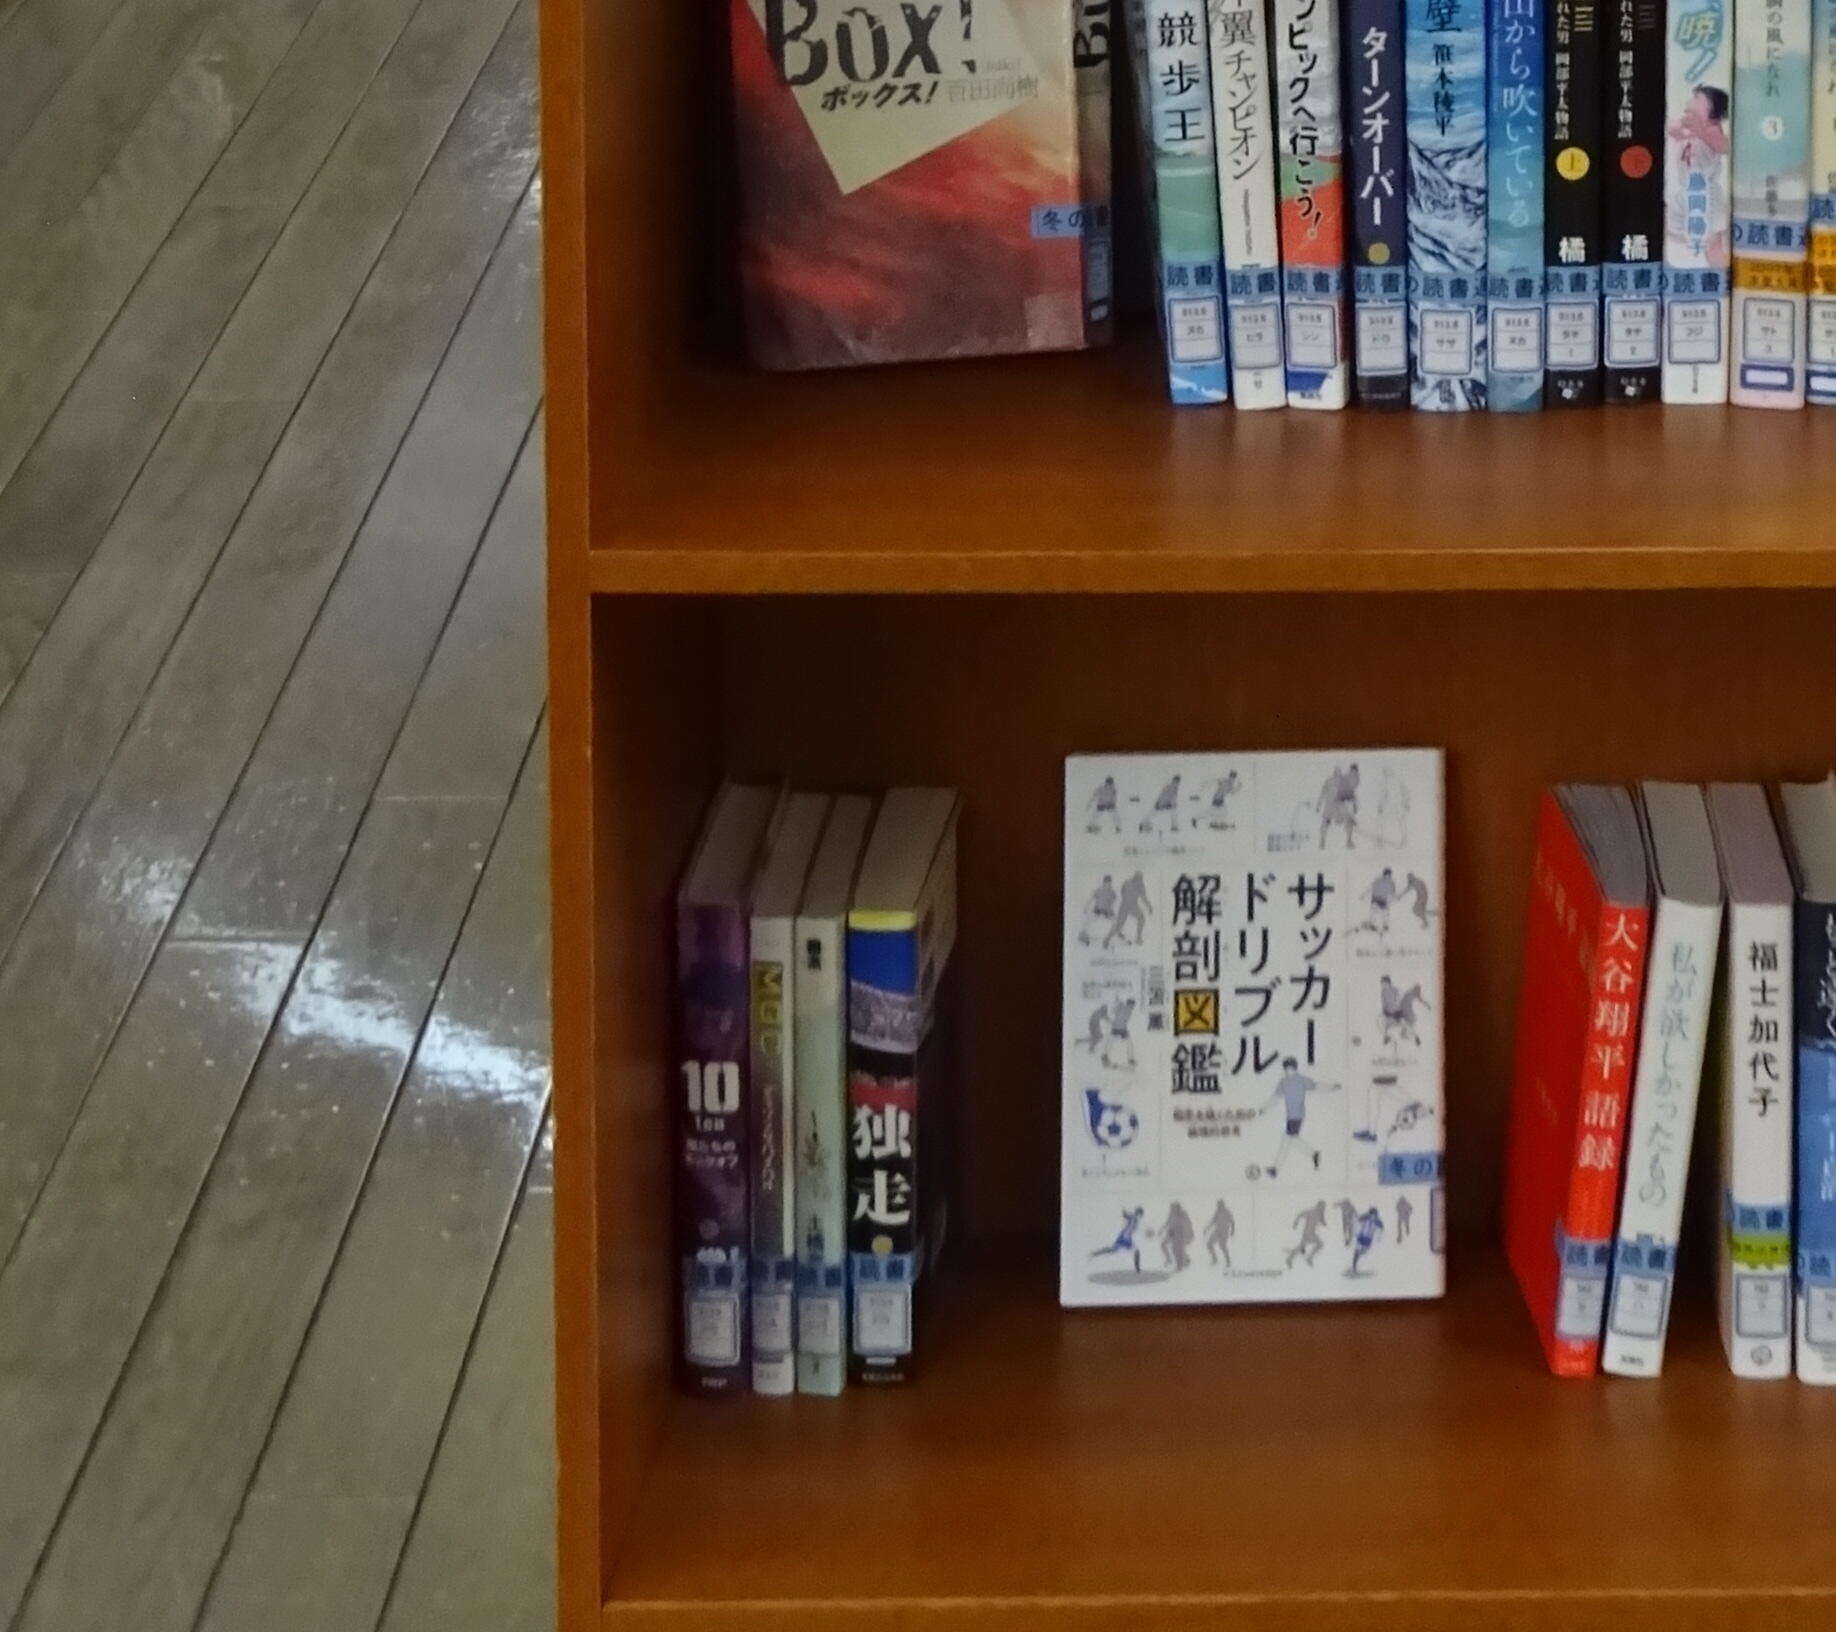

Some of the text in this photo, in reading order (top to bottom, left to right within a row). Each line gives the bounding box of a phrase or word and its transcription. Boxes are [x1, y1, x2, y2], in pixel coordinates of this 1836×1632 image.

[820, 82, 939, 113] ボックス!
[1156, 11, 1207, 144] 競歩王
[1360, 26, 1395, 226] ターンオーバー
[1431, 43, 1456, 136] 笹本稜平
[1041, 209, 1086, 230] 冬の
[1559, 236, 1586, 264] 橘
[1622, 233, 1649, 262] 橘
[1171, 872, 1222, 1095] 解剖図鑑
[1231, 871, 1283, 1077] ドリブル
[1288, 871, 1335, 1067] サッカー
[1747, 939, 1780, 1118] 福士加代子
[682, 1059, 741, 1114] 10
[852, 1102, 913, 1228] 独走
[1389, 1155, 1433, 1178] 冬の
